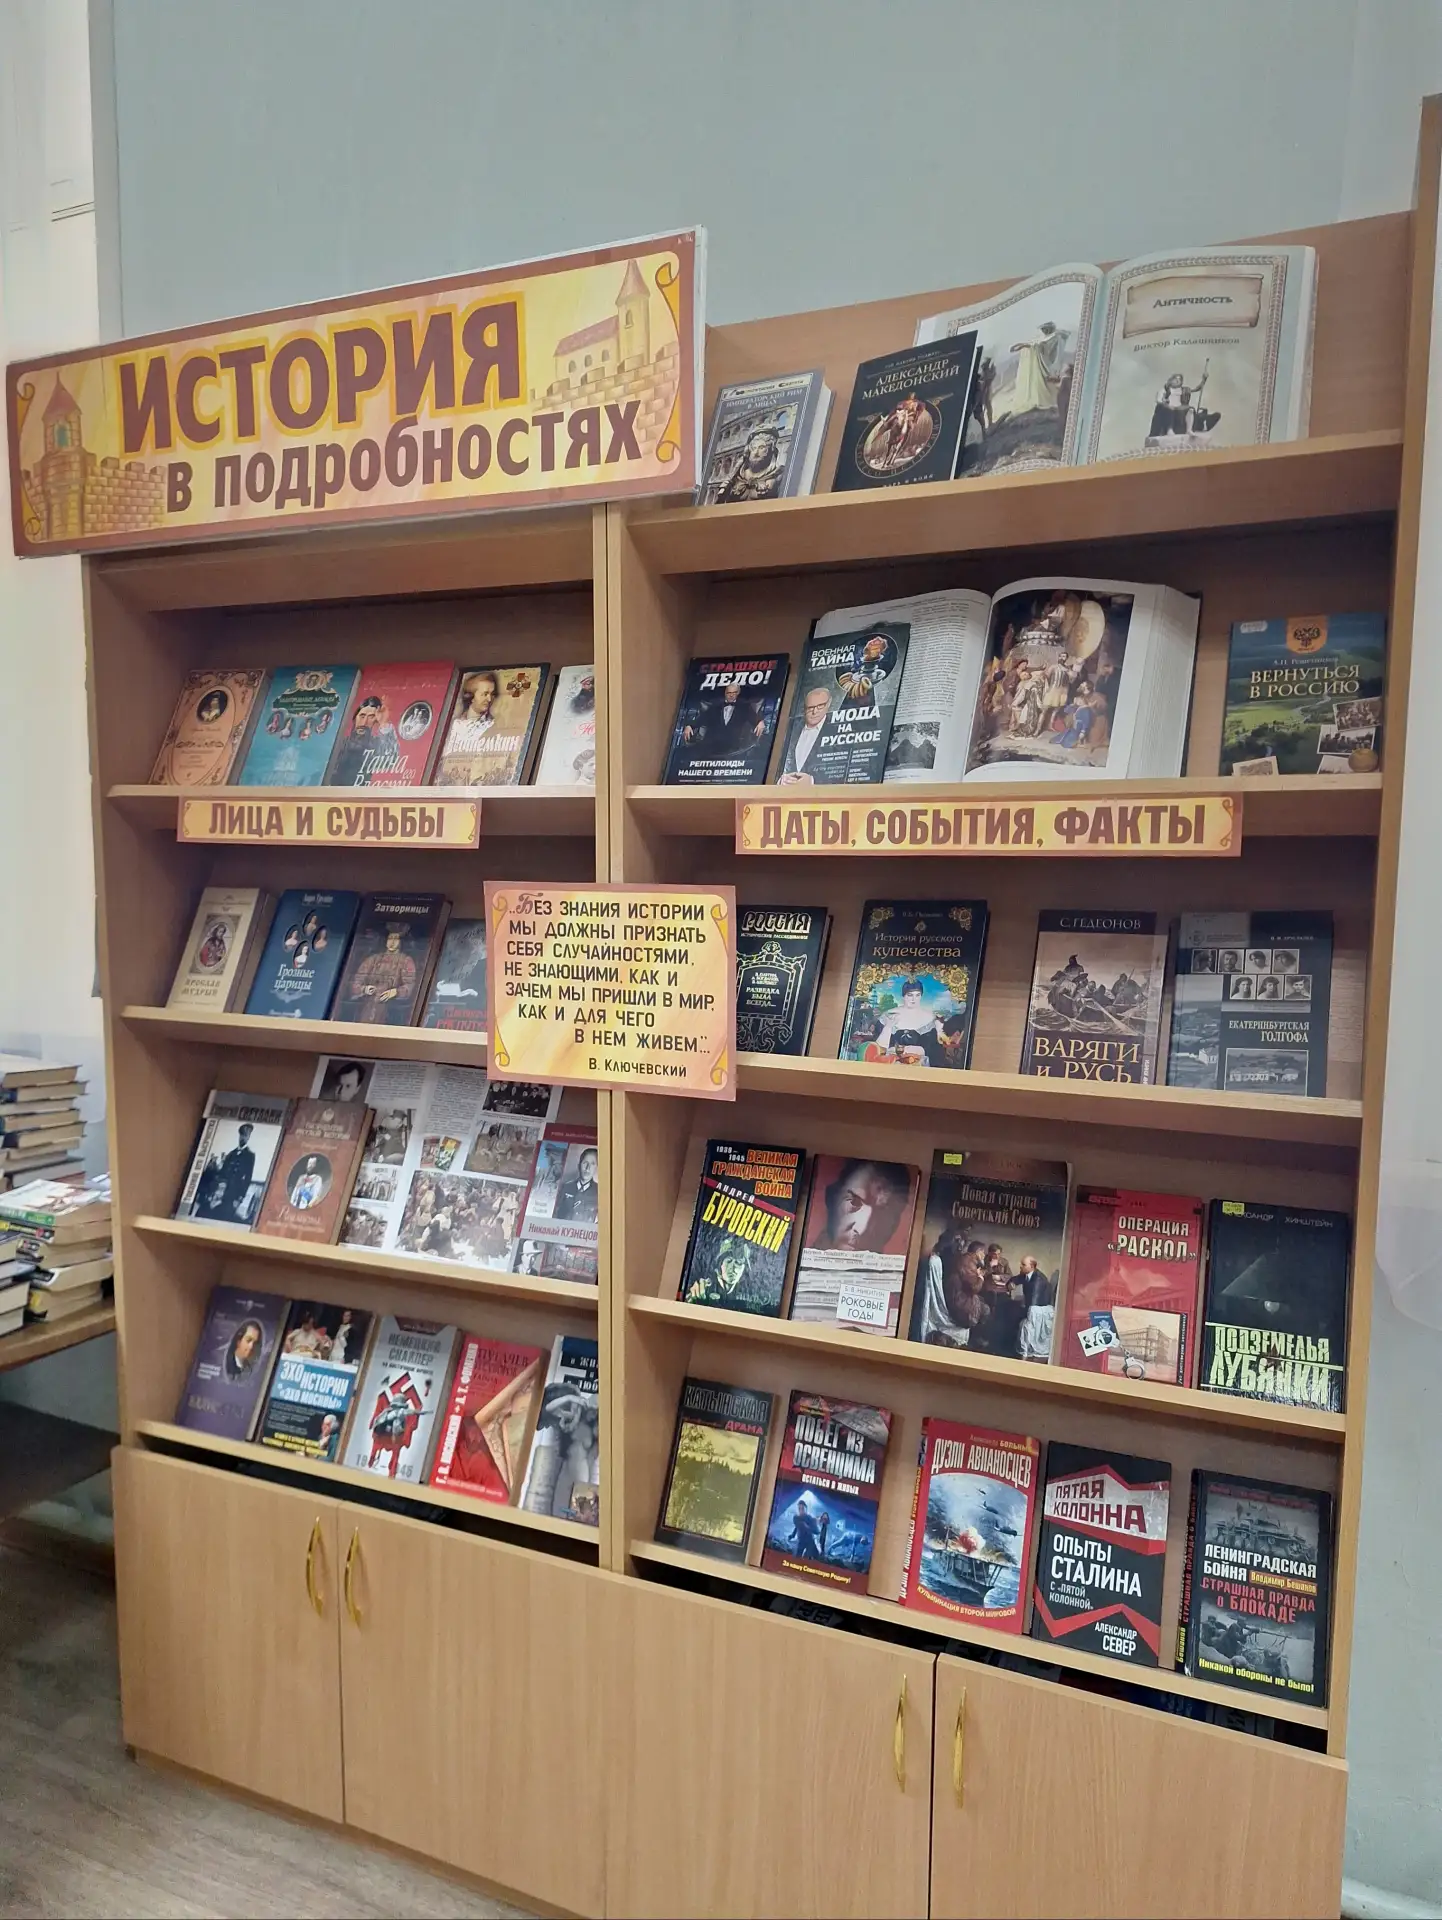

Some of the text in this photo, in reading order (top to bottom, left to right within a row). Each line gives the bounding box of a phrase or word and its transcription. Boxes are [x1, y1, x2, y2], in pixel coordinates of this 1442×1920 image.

[120, 301, 521, 453] ИСТОРИЯ
[862, 365, 961, 400] МАКЕДОНСКИЙ
[876, 359, 949, 387] АЛЕКСАНДР
[167, 461, 192, 513] в
[811, 645, 856, 658] ВОЕННАЯ
[811, 652, 855, 667] ТАЙНА
[701, 660, 778, 673] СТРАШНОЕ
[1251, 665, 1359, 684] ВЕРНУТЬСЯ
[700, 670, 772, 690] ДЕЛО!
[1250, 680, 1360, 698] В РОССИЮ
[831, 705, 881, 723] МОДА
[820, 730, 881, 747] РУССКОЕ
[837, 723, 852, 733] НА
[358, 744, 409, 775] Тайна
[689, 760, 745, 768] РЕПТИЛОИДЫ
[678, 768, 753, 777] НАШЕГО ВРЕМЕНИ
[208, 802, 445, 840] ЛИЦА И СУДЬБЫ
[760, 804, 1206, 848] ДАТЫ, СОБЫТИЯ, ФАКТЫ
[374, 903, 430, 914] Затворницы
[560, 901, 705, 920] ЗНАНИЯ ИСТОРИИ
[509, 920, 706, 944] МЫ ДОЛЖНЫ ПРИЗНАТЬ
[742, 911, 811, 933] РОССИЯ
[1073, 917, 1142, 930] ГЕДЕОНОВ
[875, 932, 963, 944] История русского
[507, 941, 543, 957] СЕБЯ
[872, 946, 961, 960] купечества
[277, 964, 315, 979] Грозные
[504, 962, 522, 977] НЕ
[629, 968, 660, 985] КАК
[667, 971, 678, 986] И
[274, 978, 313, 991] царицы
[505, 982, 552, 999] ЗАЧЕМ
[558, 986, 585, 1001] МЫ
[592, 987, 656, 1006] ПРИШЛИ
[662, 992, 673, 1008] В
[746, 987, 780, 995] РАЗВЕДКА
[518, 1004, 655, 1027] КАК И ДЛЯ ЧЕГО
[1228, 1020, 1310, 1031] ЕКАТЕРИНБУРГСКАЯ
[574, 1028, 626, 1047] В НЕМ
[1260, 1031, 1309, 1043] ГОЛГОФА
[1032, 1037, 1140, 1063] ВАРЯГИ
[589, 1058, 600, 1070] В.
[1036, 1065, 1051, 1077] и
[1064, 1060, 1132, 1084] РУСЬ
[728, 1149, 799, 1166] 1945 ВЕЛИКАЯ
[712, 1162, 795, 1183] ГРАЖДАНСКАЯ
[715, 1182, 755, 1203] АНДРЕЙ
[755, 1180, 792, 1198] ВОЙНА
[961, 1184, 1038, 1210] Новая страна
[702, 1191, 790, 1254] БУРОВСКИЙ
[952, 1201, 1040, 1229] Советский Союз
[1118, 1215, 1189, 1236] ОПЕРАЦИЯ
[528, 1223, 560, 1237] Николай
[1107, 1234, 1196, 1262] «РАСКОЛ»
[841, 1296, 885, 1311] РОКОВЫЕ
[848, 1308, 874, 1320] ГОДЫ
[1214, 1325, 1330, 1363] ПОДЗЕМЕЛЬЯ
[280, 1361, 349, 1397] ЭХО ИСТОРИИ
[1208, 1350, 1330, 1404] ЛУБЯНКИ
[683, 1385, 769, 1421] КАТЫНСКАЯ
[724, 1420, 764, 1435] ДРАМА
[794, 1414, 865, 1454] ПОБЕГ ИЗ
[793, 1442, 876, 1484] ОСВЕНЦИМА
[931, 1438, 1032, 1489] ДУЭЛИ АВИАНОСЦЕВ
[801, 1473, 860, 1495] ОСТАТЬСЯ В ЖИВЫХ
[1055, 1479, 1104, 1499] ПЯТАЯ
[1053, 1501, 1147, 1534] КОЛОННА
[1053, 1534, 1112, 1563] ОПЫТЫ
[1203, 1560, 1247, 1581] БОЙНЯ
[1204, 1543, 1317, 1579] ЛЕНИНГРАДСКАЯ
[1050, 1581, 1056, 1591] С
[1051, 1556, 1142, 1597] СТАЛИНА
[1251, 1572, 1317, 1593] Владимир Бешанов
[917, 1585, 1016, 1618] КУЛЬМИНАЦИЯ ВТОРОЙ МИРОВОЙ
[1202, 1576, 1316, 1612] СТРАШНАЯ ПРАВДА
[1217, 1596, 1296, 1623] О БЛОКАДЕ
[1095, 1622, 1137, 1639] АЛЕКСАНДР
[1102, 1635, 1137, 1656] СЕВЕР
[1199, 1657, 1315, 1693] Никакой обороны не было!
